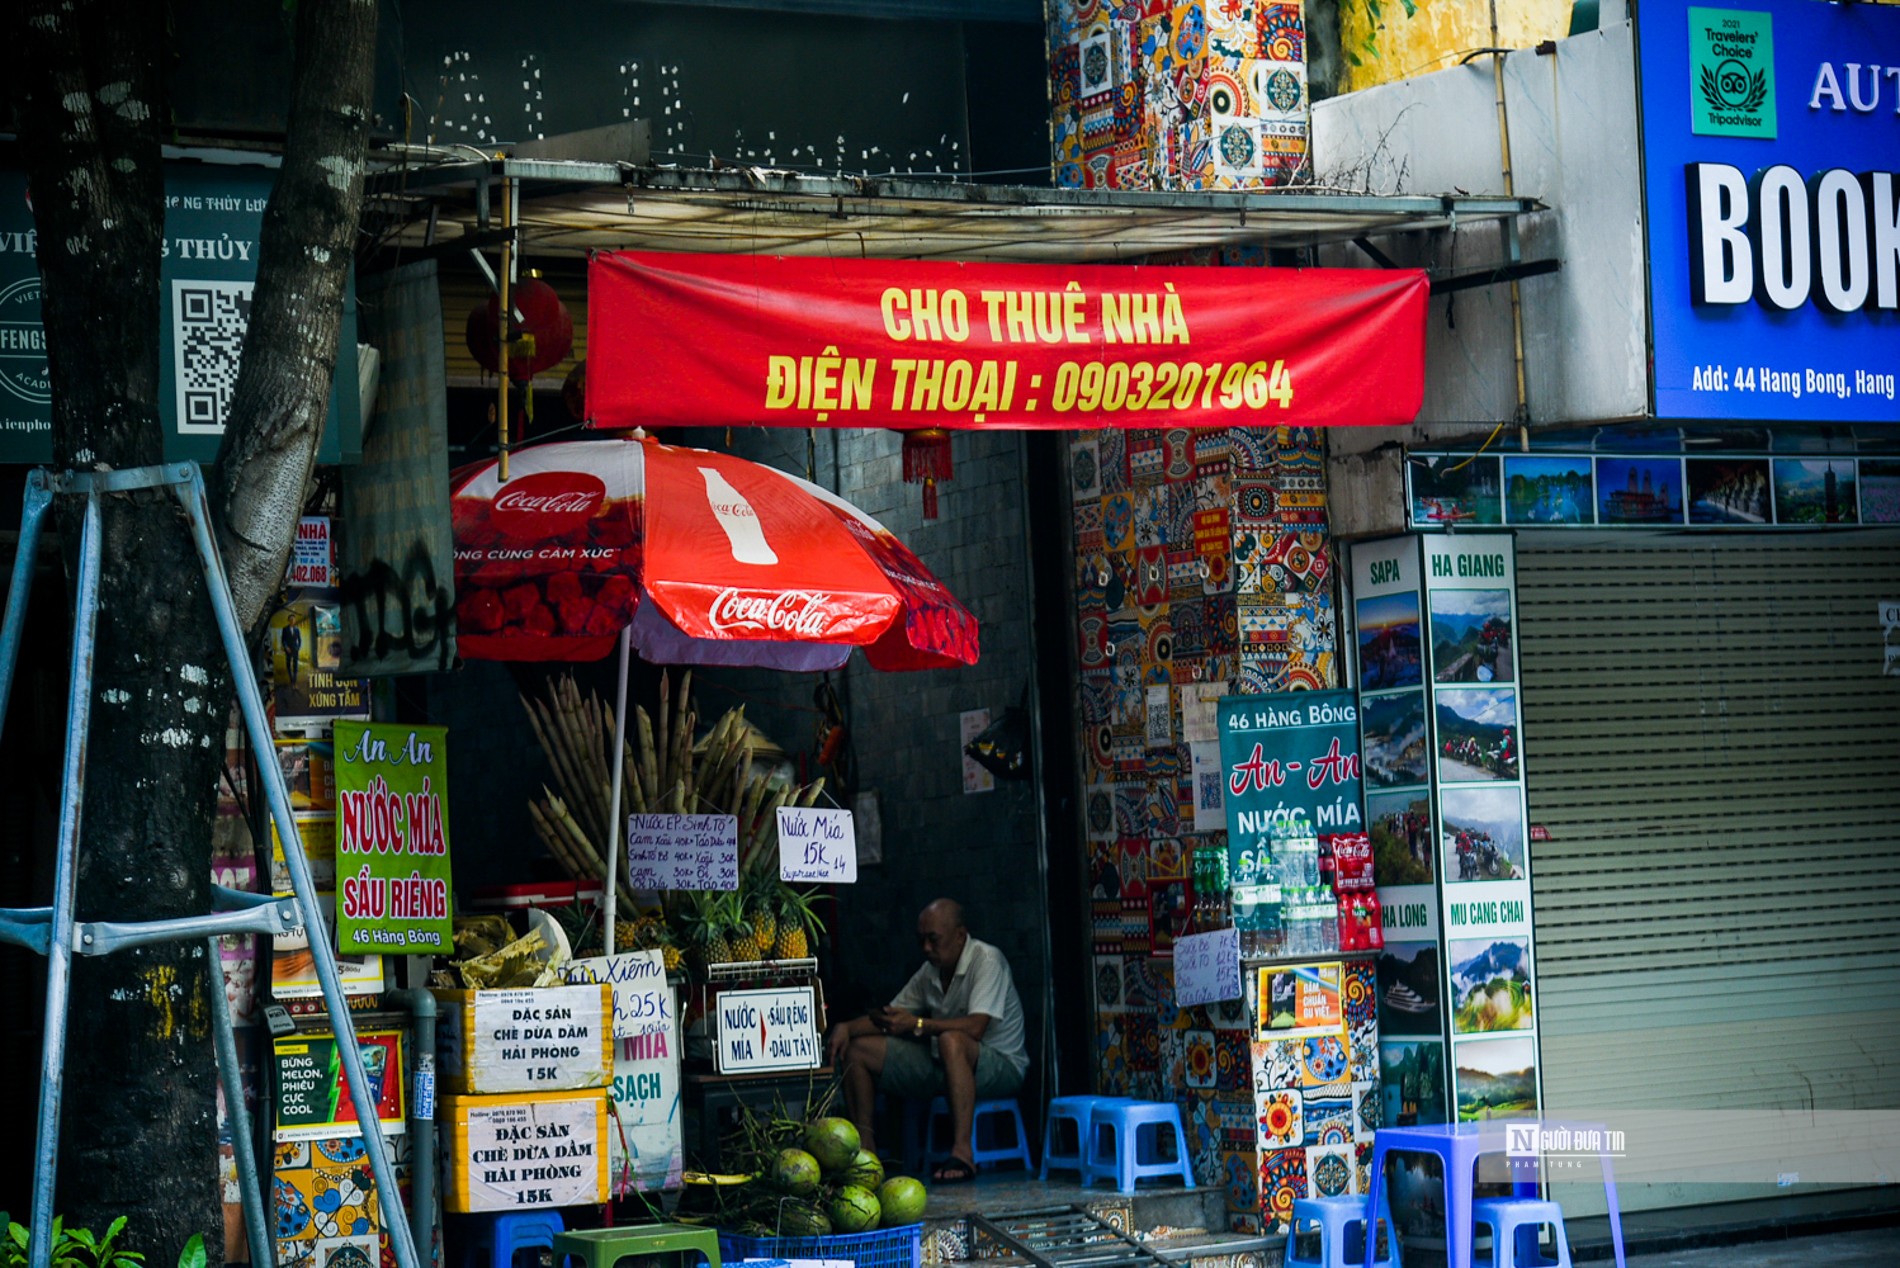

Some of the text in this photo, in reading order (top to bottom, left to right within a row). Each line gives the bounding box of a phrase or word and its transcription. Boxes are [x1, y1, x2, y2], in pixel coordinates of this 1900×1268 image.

[1722, 19, 1740, 28] 2021
[1708, 112, 1762, 127] Tripadvisor
[0, 228, 38, 258] VIỆ
[175, 232, 252, 261] THỦY
[1697, 162, 1900, 312] BOOK
[15, 290, 41, 304] VIET
[881, 282, 1190, 345] CHO THUÊ NHÀ
[16, 372, 51, 389] ACAD
[766, 345, 876, 422] ĐIỆN
[890, 359, 1018, 422] THOẠI
[1052, 359, 1293, 411] 0903201964
[1692, 364, 1895, 400] Add: 44 Hang Bong, Hang
[298, 520, 328, 540] NHÀ
[487, 546, 534, 560] CÙNG
[1370, 554, 1505, 585] SAPA HA GIANG
[1229, 703, 1357, 729] 46 HÀNG BÔNG
[344, 729, 433, 765] An An
[341, 774, 404, 855] NƯỚC
[405, 776, 446, 856] MÍA
[1317, 796, 1361, 827] MÍA
[343, 864, 448, 919] SẦU RIÊNG
[1382, 900, 1525, 928] HA LONG MU CANG CHAI
[353, 928, 440, 946] 46 Hàng Bông
[725, 1000, 756, 1030] NƯỚC
[524, 1024, 552, 1039] DỪA
[531, 1043, 580, 1059] PHÒNG
[731, 1032, 753, 1061] MÍA
[281, 1056, 313, 1068] BỪNG
[282, 1069, 323, 1080] MELON,
[282, 1092, 304, 1105] CỰC
[613, 1073, 661, 1109] SẠCH
[283, 1104, 313, 1116] COOL
[496, 1124, 531, 1144] ĐẶC
[472, 1146, 508, 1163] CHÈ
[513, 1144, 549, 1160] DỪA
[521, 1164, 581, 1181] PHÒNG
[516, 1188, 553, 1204] 15K
